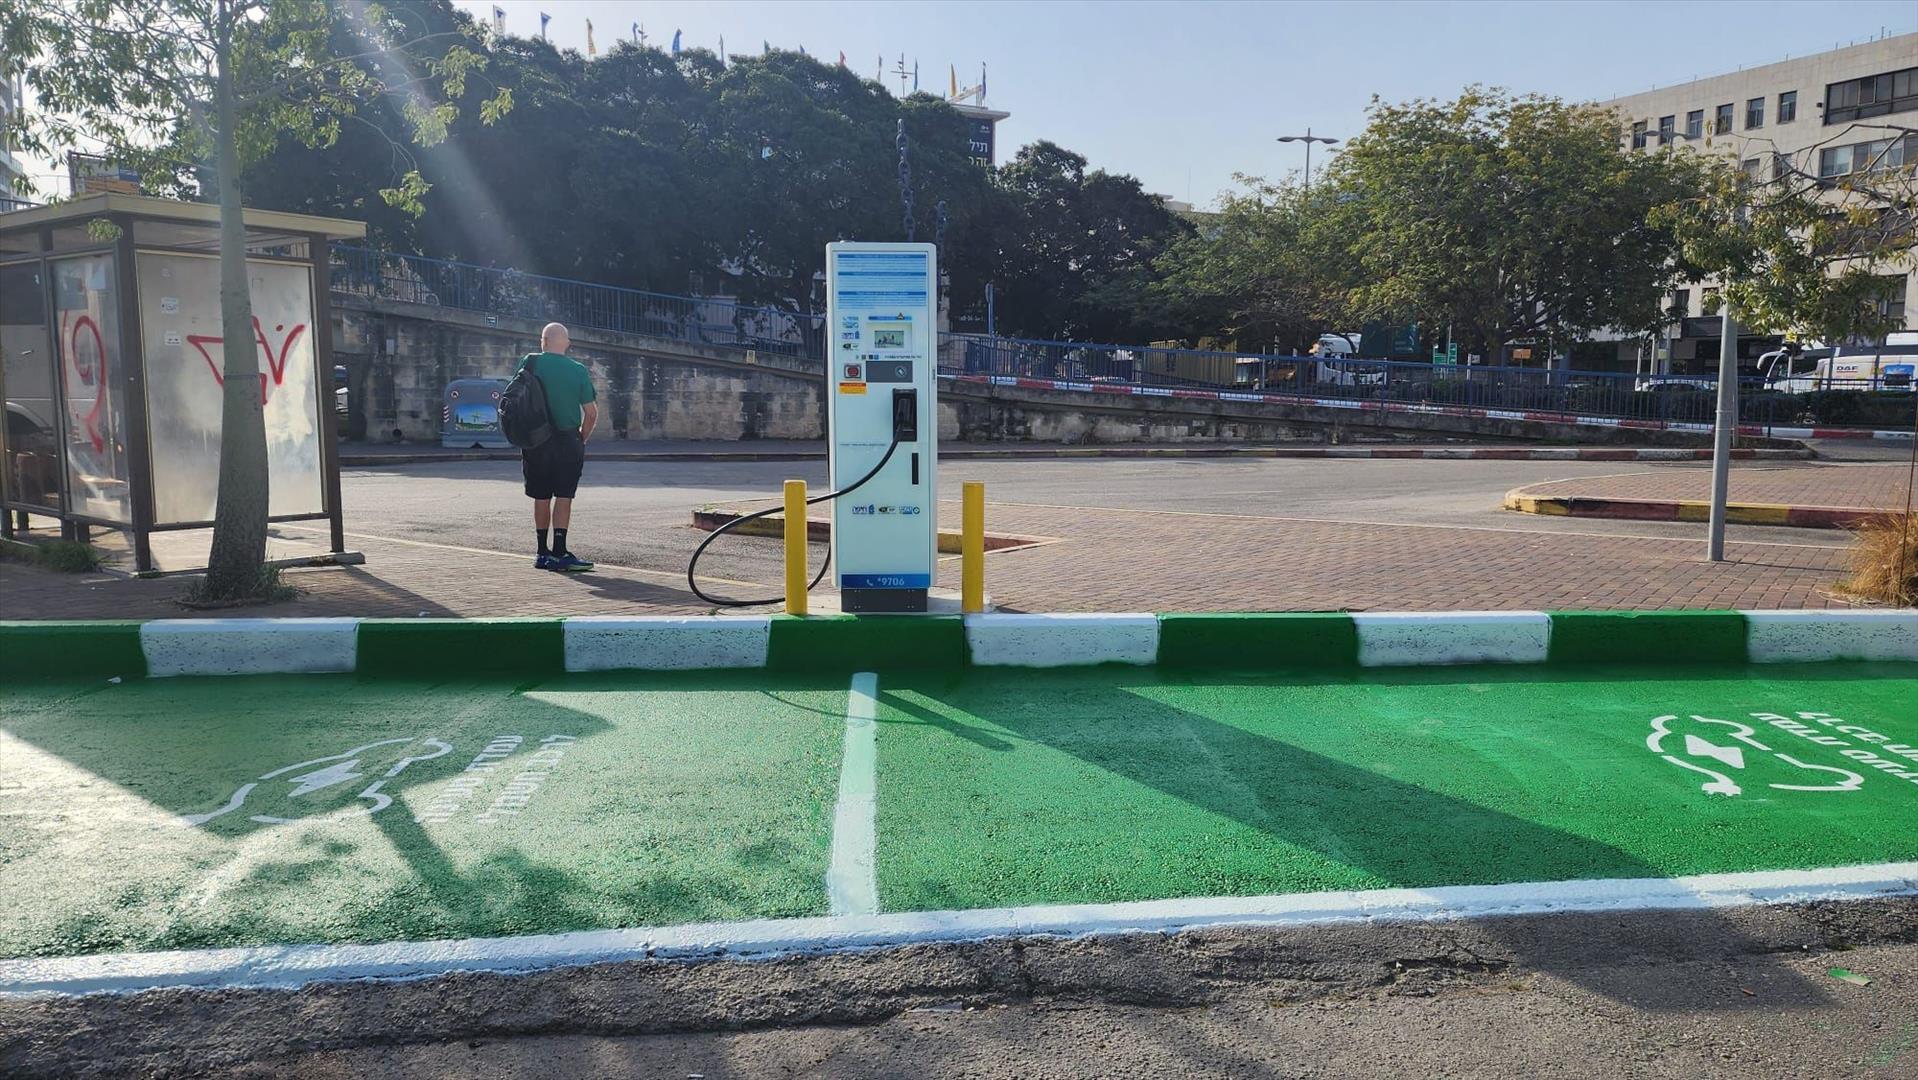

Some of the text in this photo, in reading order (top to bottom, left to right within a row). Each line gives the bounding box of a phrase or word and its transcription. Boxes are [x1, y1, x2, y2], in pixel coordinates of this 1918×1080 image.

[1795, 711, 1891, 744] לרכב
[464, 735, 523, 772] עמדת
[1750, 712, 1851, 746] עמדת
[1840, 750, 1918, 785] טעינ
